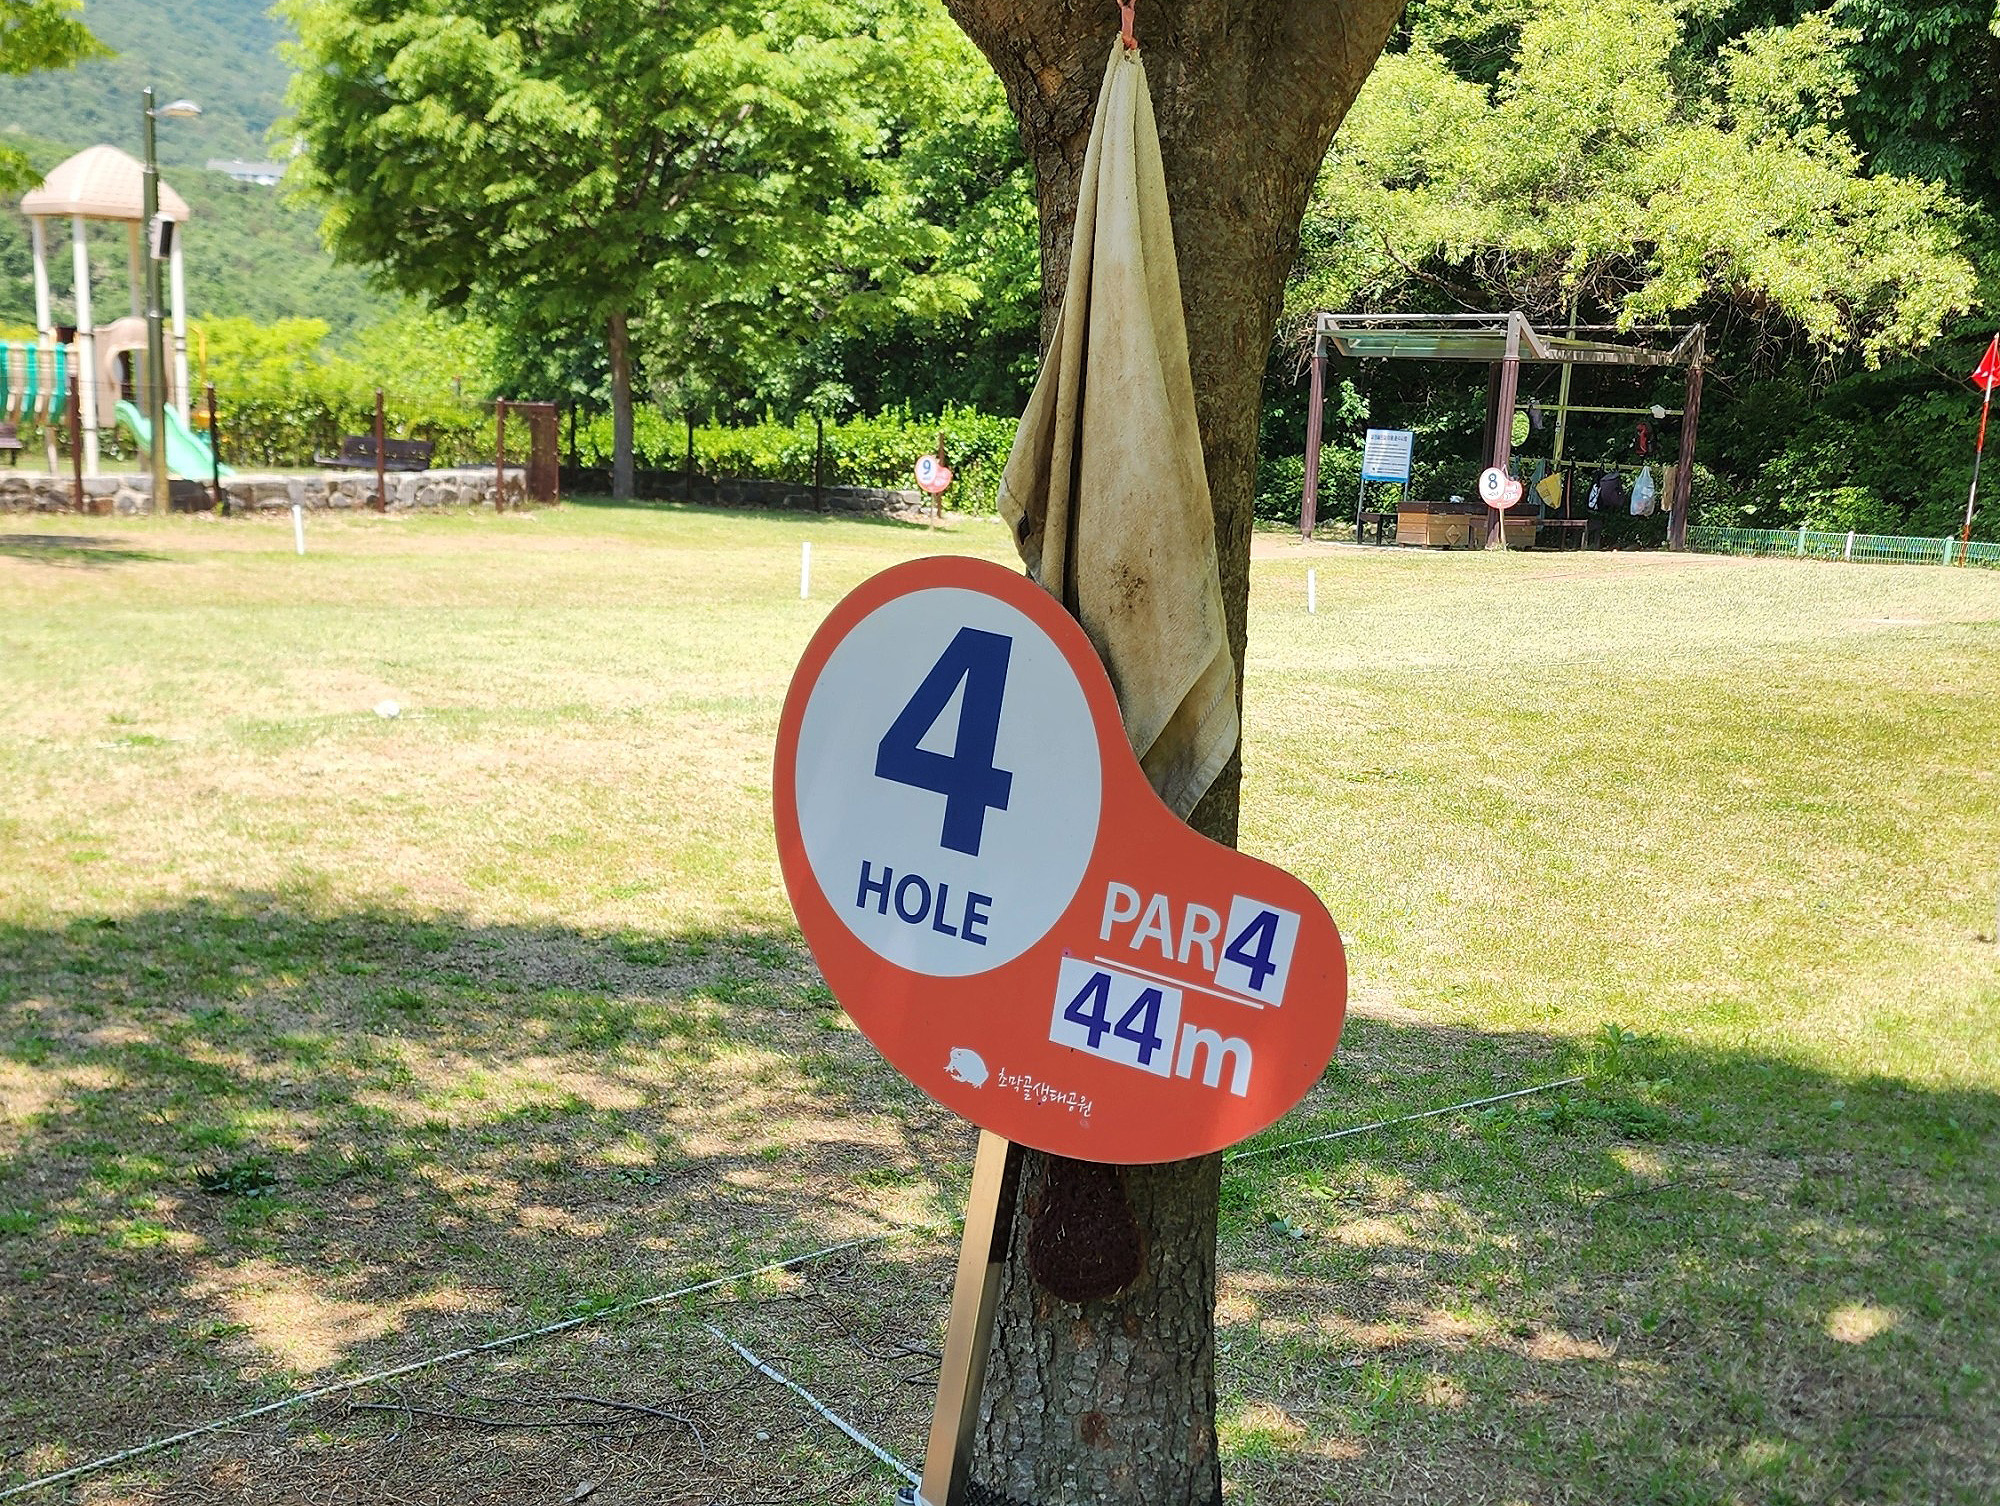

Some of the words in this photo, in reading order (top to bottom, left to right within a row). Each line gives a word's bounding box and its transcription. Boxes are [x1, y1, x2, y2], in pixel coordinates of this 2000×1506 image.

[922, 459, 932, 475] 9
[1488, 473, 1498, 490] 8
[874, 626, 1013, 857] 4
[856, 859, 993, 946] HOLE
[998, 1066, 1093, 1117] 초막골생태공원
